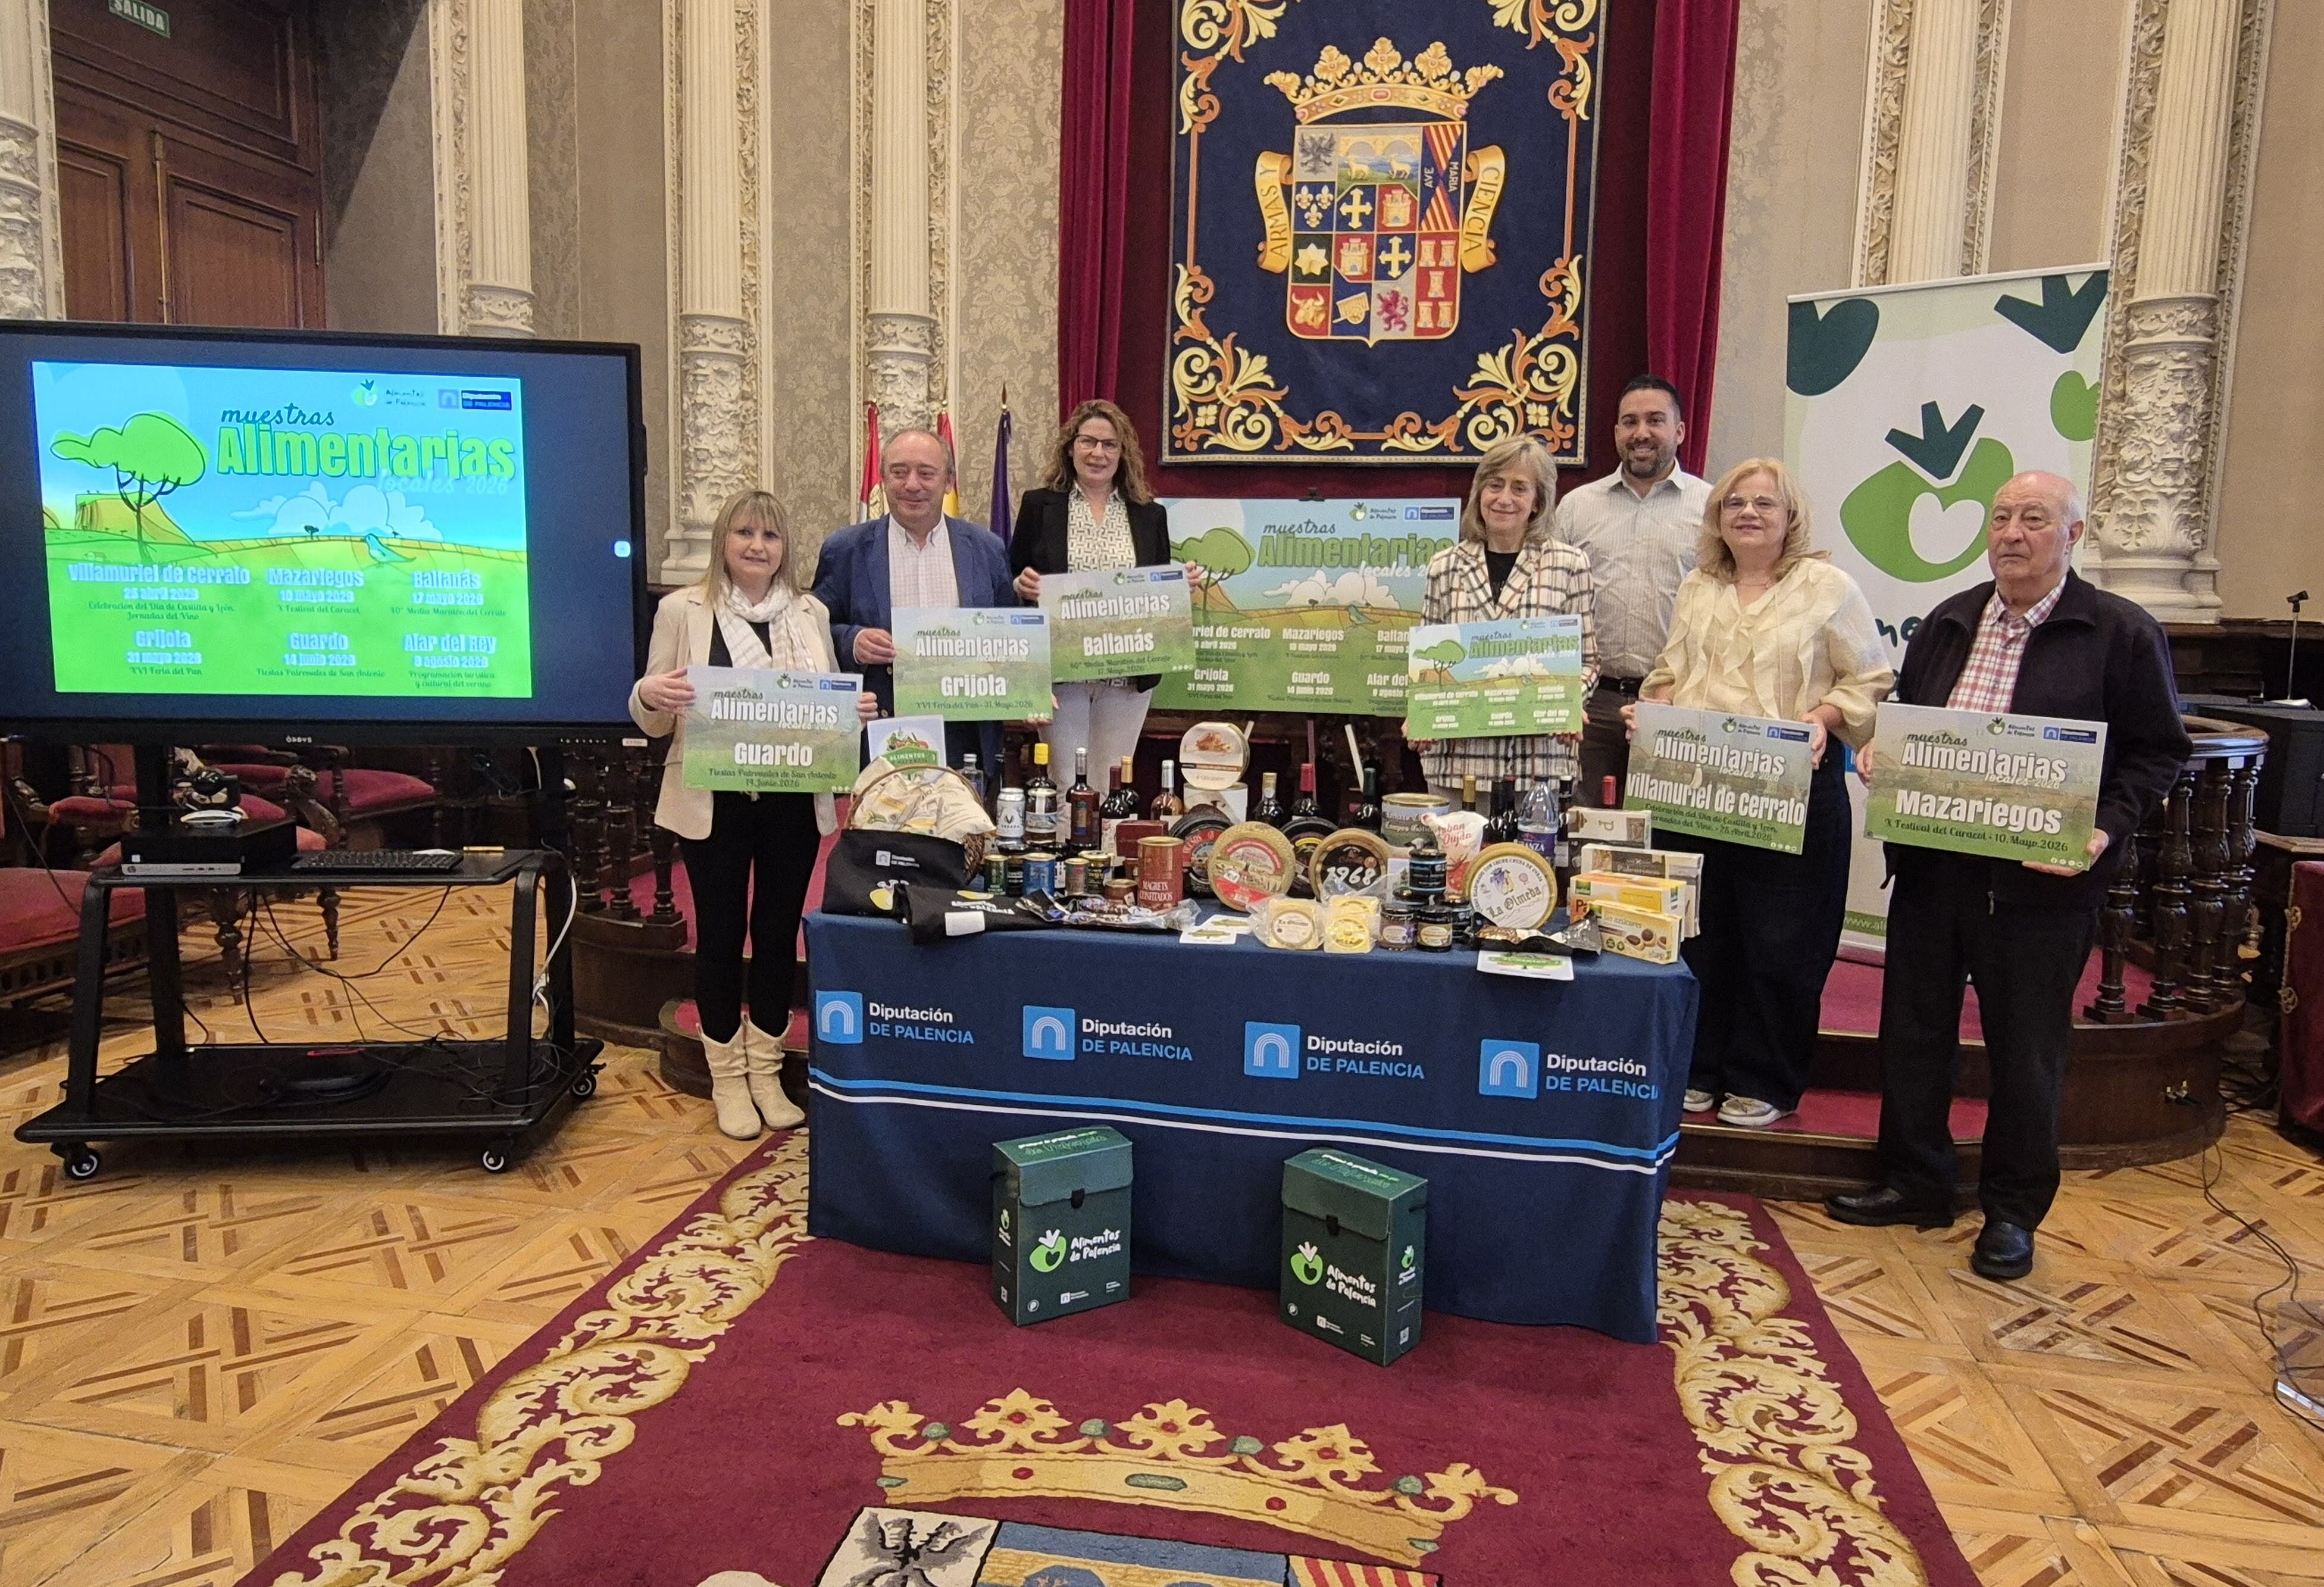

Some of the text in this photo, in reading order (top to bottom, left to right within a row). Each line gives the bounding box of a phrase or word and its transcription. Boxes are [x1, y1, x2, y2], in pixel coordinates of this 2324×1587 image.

[114, 0, 165, 30] SALIDA
[1424, 161, 1459, 193] AVE MARIA
[1259, 164, 1288, 258] ARMAS Y
[1464, 167, 1500, 253] CIENCIA
[221, 402, 334, 426] muestras
[217, 423, 516, 480] Alimentarias
[377, 467, 509, 494] locales 2026
[1263, 518, 1336, 534] muestras
[161, 564, 183, 583] de
[266, 567, 365, 588] Mazariegos
[1359, 560, 1411, 578] locales
[1061, 588, 1103, 600] muestras
[1061, 593, 1171, 620] Alimentarias
[288, 632, 349, 650] Guardo
[440, 634, 465, 652] del
[917, 627, 961, 637] muestras
[1083, 627, 1155, 657] Baltanás
[1215, 626, 1229, 638] de
[1282, 627, 1345, 642] Mazariegos
[1377, 629, 1409, 642] Baltan
[1471, 631, 1512, 641] muestras
[915, 635, 1030, 658] Alimentarias
[1469, 634, 1579, 659] Alimentarias
[941, 673, 1006, 698] Grijota
[1291, 671, 1330, 684] Guardo
[1367, 673, 1390, 686] Alar
[714, 688, 763, 699] muestras
[711, 697, 839, 724] Alimentarias
[1657, 729, 1706, 742] muestras
[1906, 730, 1968, 746] muestras
[734, 742, 813, 767] Guardo
[1652, 737, 1785, 776] Alimentarias
[1901, 742, 2068, 784] Alimentarias
[1984, 773, 2031, 786] locales
[1627, 772, 1713, 811] Villamuriel
[1714, 786, 1736, 814] de
[1895, 789, 2063, 835] Mazariegos
[1932, 826, 1947, 835] del
[1949, 828, 1987, 841] Caracol
[1327, 866, 1376, 887] 1968
[1486, 886, 1542, 919] La Olmeda
[869, 1002, 953, 1023] Diputación
[869, 1023, 974, 1044] DE PALENCIA
[1082, 1018, 1172, 1039] Diputación
[1082, 1038, 1193, 1061] DE PALENCIA
[1307, 1035, 1403, 1057] Diputación
[1306, 1057, 1425, 1080] DE PALENCIA
[1547, 1054, 1647, 1077] Diputación
[1546, 1075, 1659, 1099] DE PALENCI
[1070, 1229, 1121, 1250] Alimentos
[1069, 1242, 1122, 1263] de Palencia
[1327, 1264, 1376, 1294] Alimentos
[1326, 1278, 1376, 1308] de Palencia
